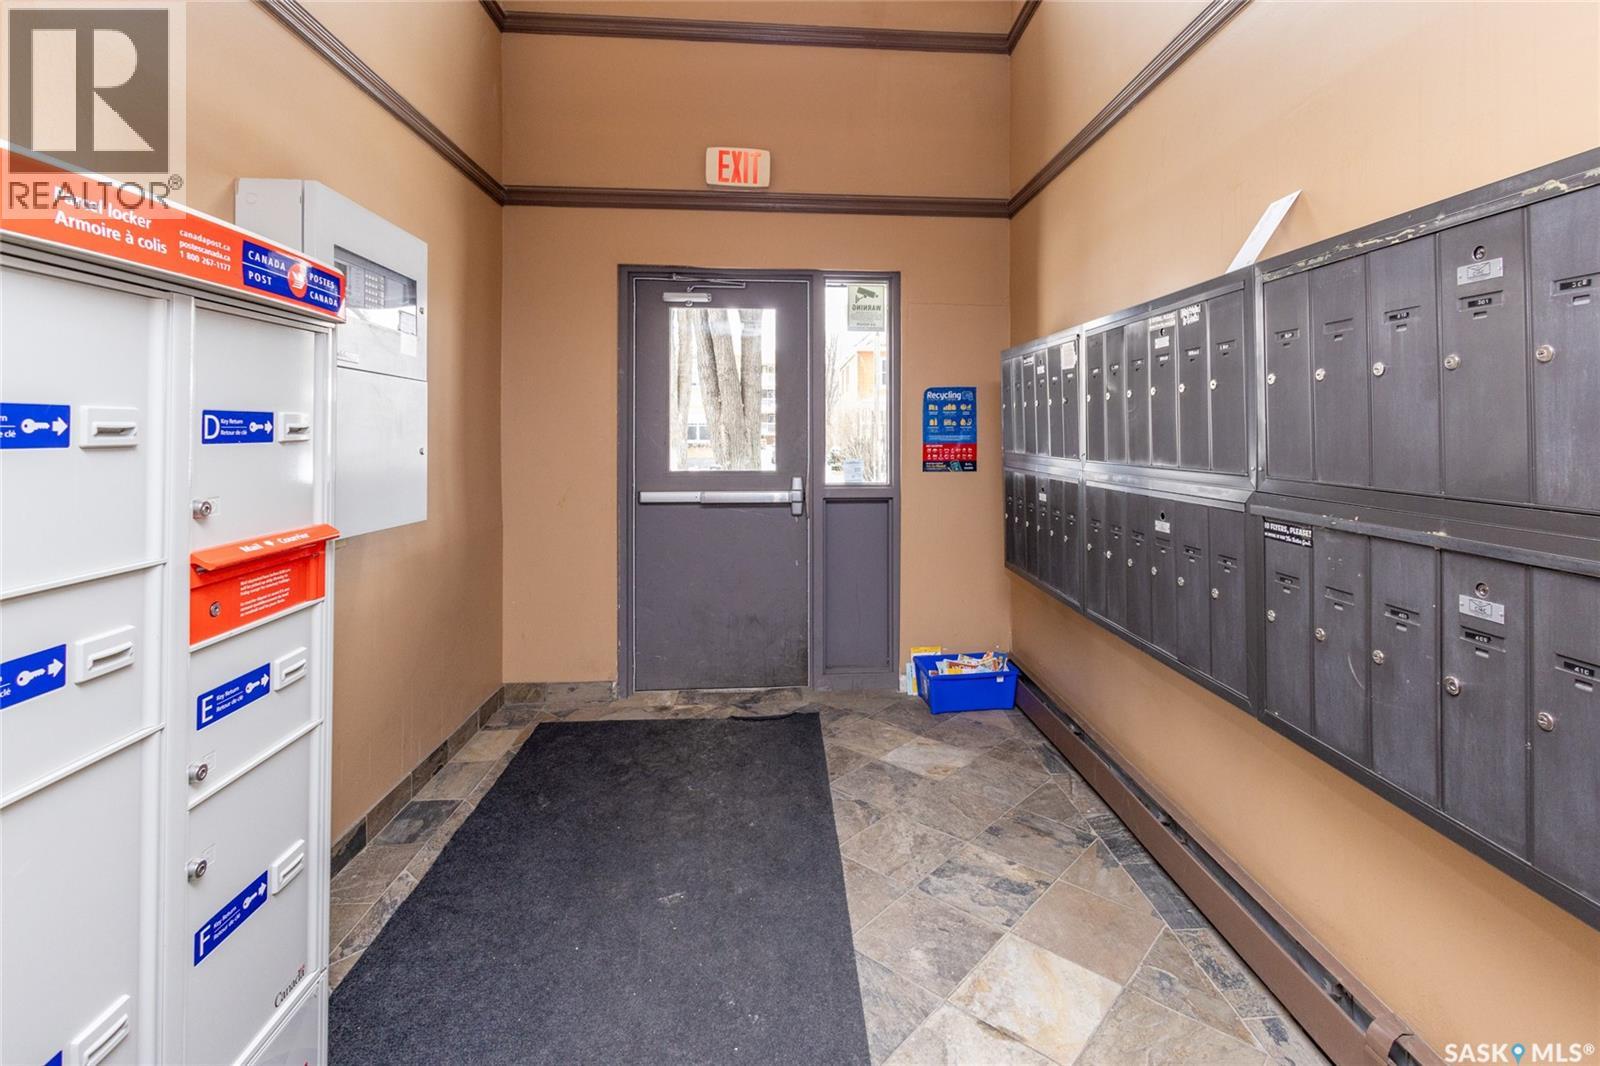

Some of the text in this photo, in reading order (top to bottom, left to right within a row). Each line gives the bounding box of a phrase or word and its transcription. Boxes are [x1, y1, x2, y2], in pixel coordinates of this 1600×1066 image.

[718, 150, 762, 184] EXIT
[107, 205, 152, 229] locker
[54, 210, 168, 254] Armoire à colis
[179, 229, 231, 251] canadapost.ca
[178, 240, 231, 262] postescanada.ca
[186, 252, 200, 263] 800
[201, 256, 232, 272] 267-1177
[247, 250, 286, 271] CANADA
[247, 270, 272, 285] POST
[308, 272, 335, 290] POSTES
[309, 290, 339, 308] CANADA
[926, 391, 962, 400] Recycling
[204, 414, 220, 440] D
[202, 695, 213, 723] E
[200, 924, 211, 957] F
